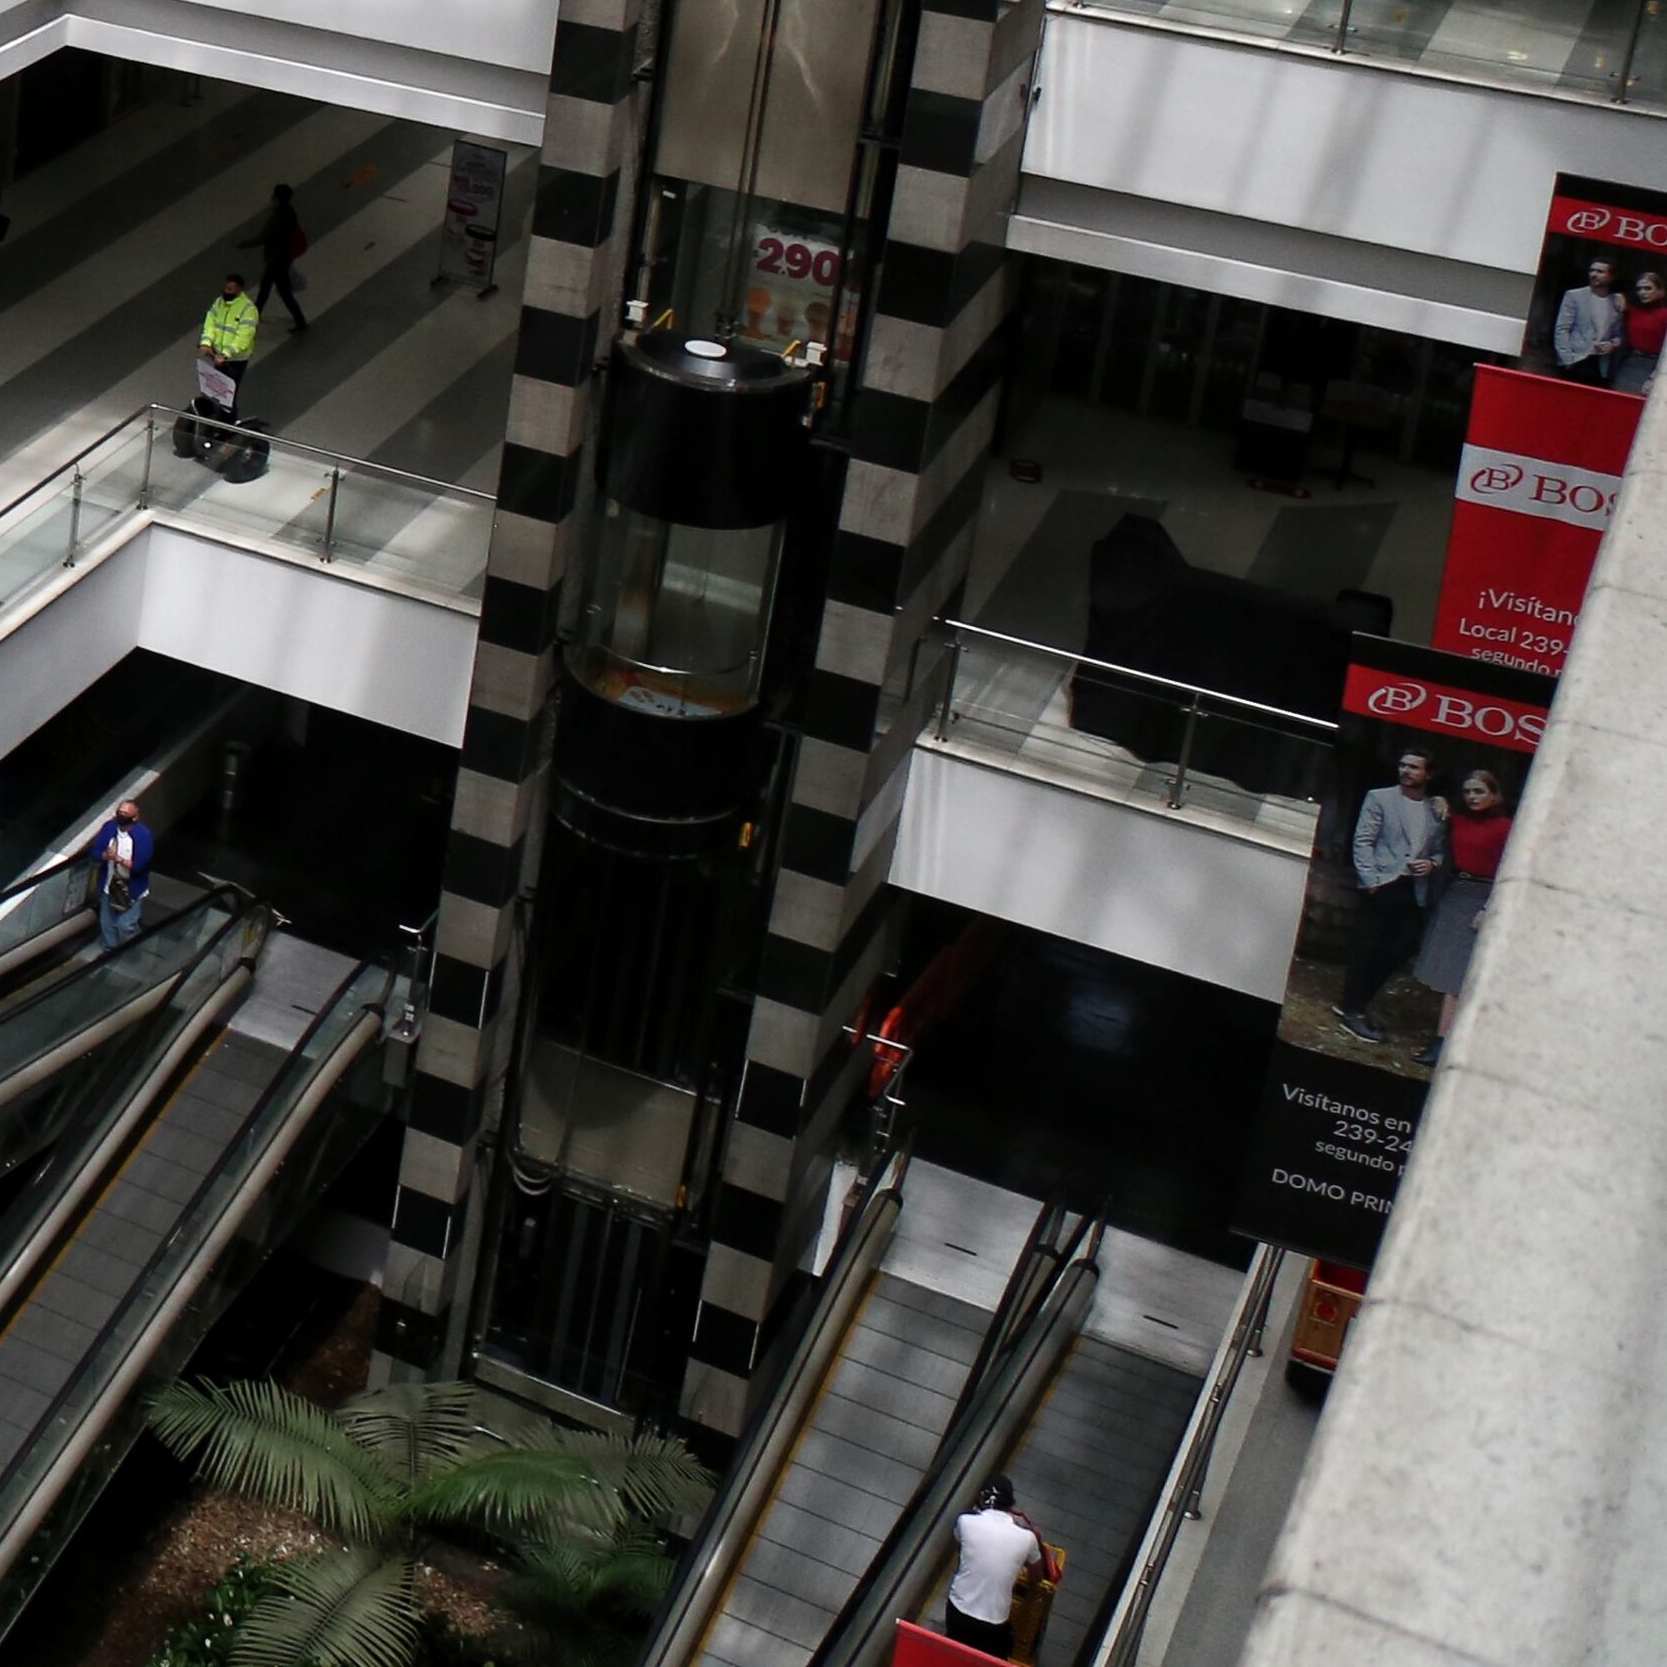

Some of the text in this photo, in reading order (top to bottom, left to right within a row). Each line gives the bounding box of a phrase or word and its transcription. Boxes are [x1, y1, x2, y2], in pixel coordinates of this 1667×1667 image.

[1459, 617, 1516, 643] Local
[1282, 1082, 1412, 1134] Visítanos en
[1315, 1140, 1395, 1172] segundo
[1271, 1168, 1346, 1200] DOMO
